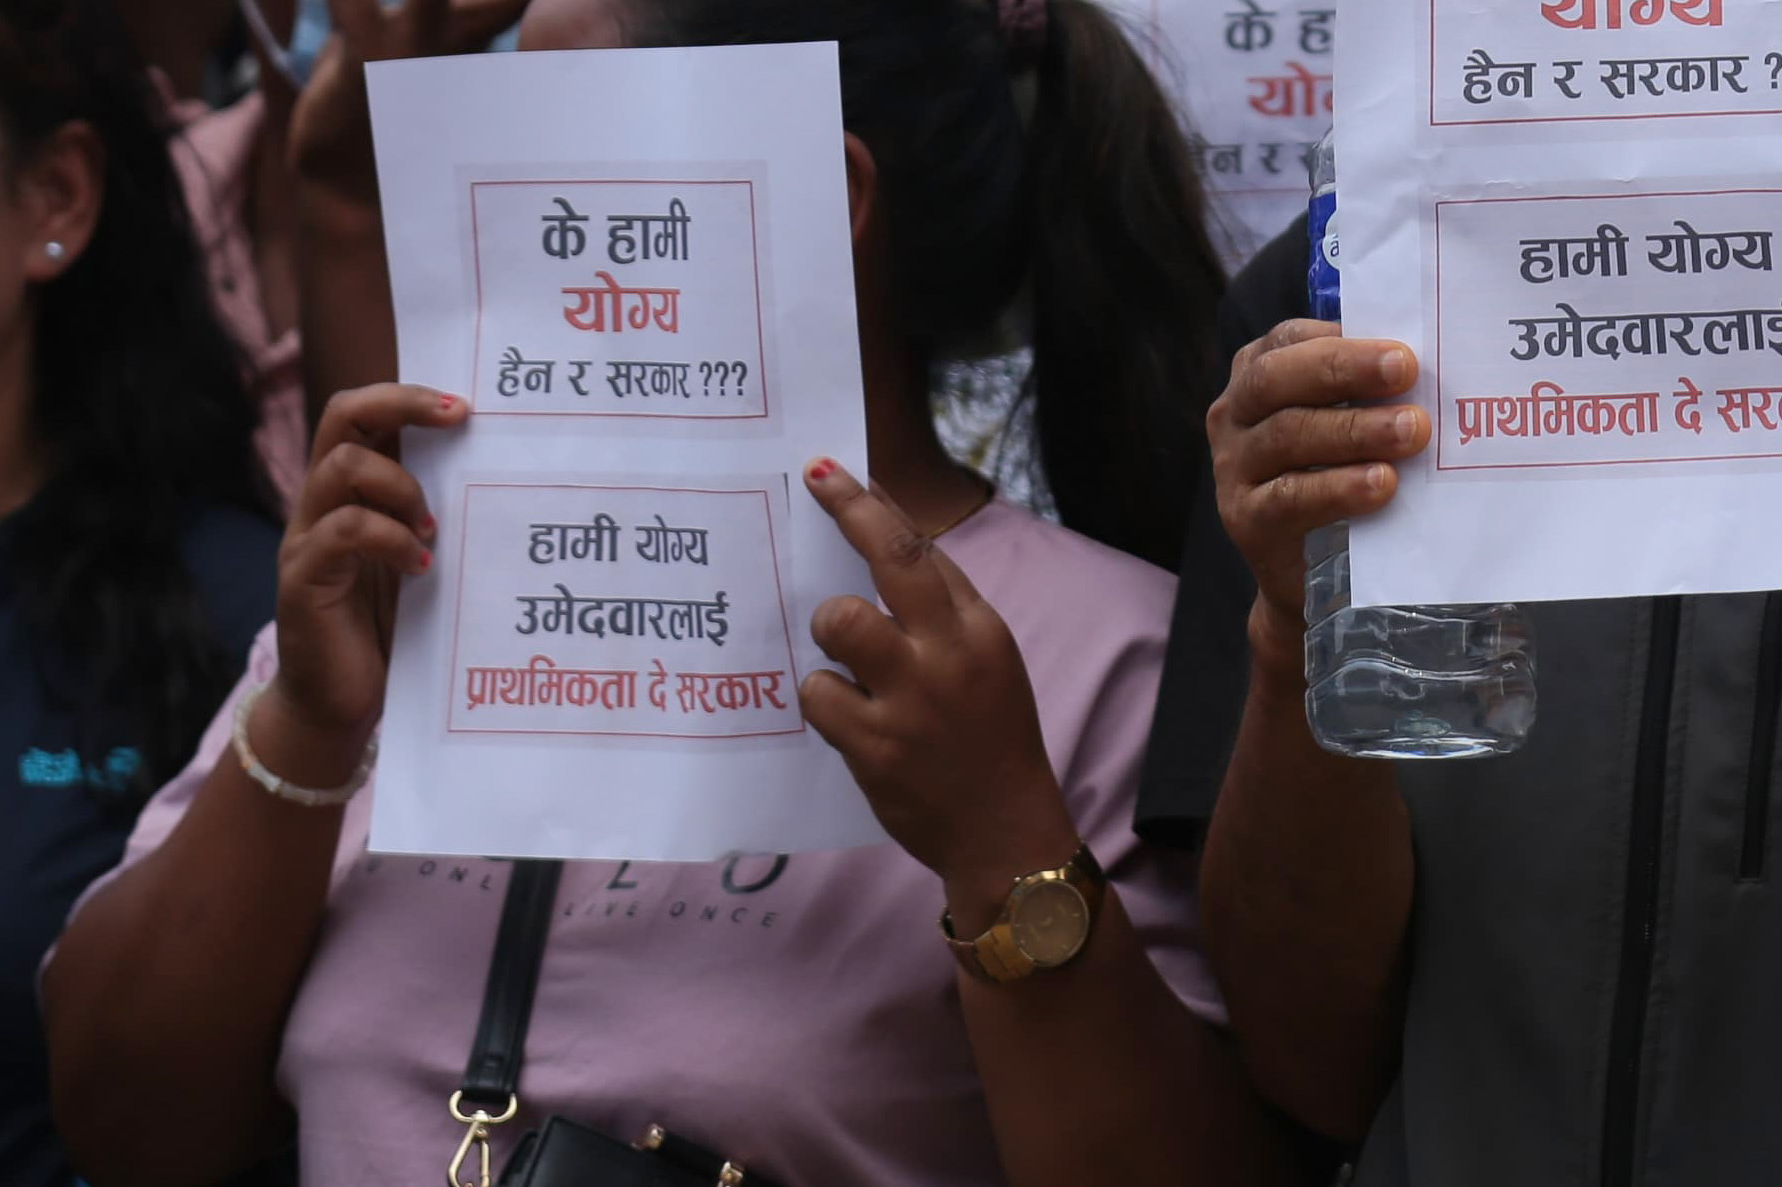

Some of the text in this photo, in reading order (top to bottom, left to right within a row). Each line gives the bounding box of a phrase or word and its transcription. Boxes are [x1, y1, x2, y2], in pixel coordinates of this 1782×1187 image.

[1463, 50, 1537, 104] हैन
[1553, 61, 1583, 98] र
[1599, 56, 1749, 99] सरकार
[542, 198, 691, 264] के हामी
[1520, 221, 1773, 283] हामी योग्य
[561, 271, 680, 333] योग्य
[498, 347, 747, 398] हैन र सरकार ???
[1455, 382, 1660, 445] प्राथमिकता
[1673, 377, 1703, 434] दे
[529, 513, 708, 566] हामी योग्य
[516, 584, 730, 647] उमेदवारलाई
[467, 655, 786, 712] प्राथमिकता दे सरकार
[668, 901, 777, 928] ONCE
